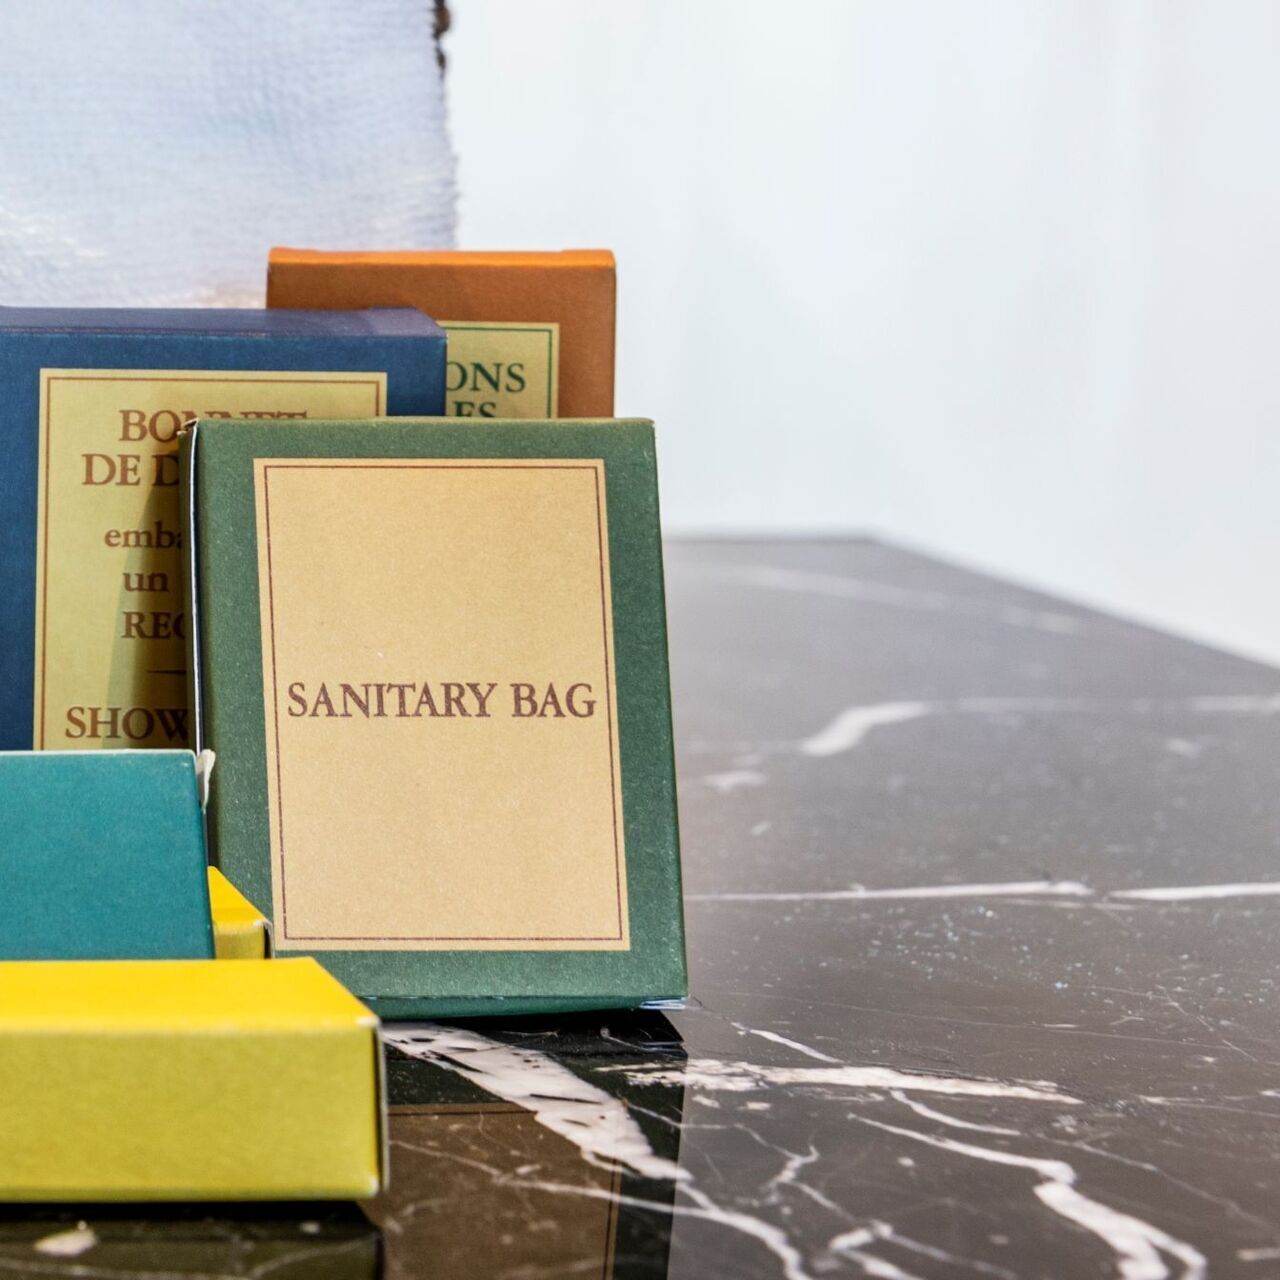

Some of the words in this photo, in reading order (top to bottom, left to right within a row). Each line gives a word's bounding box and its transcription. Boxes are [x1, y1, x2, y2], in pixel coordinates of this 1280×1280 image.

[81, 453, 140, 486] DE
[122, 571, 169, 593] un
[287, 681, 498, 719] SANITARY
[510, 682, 597, 718] BAG
